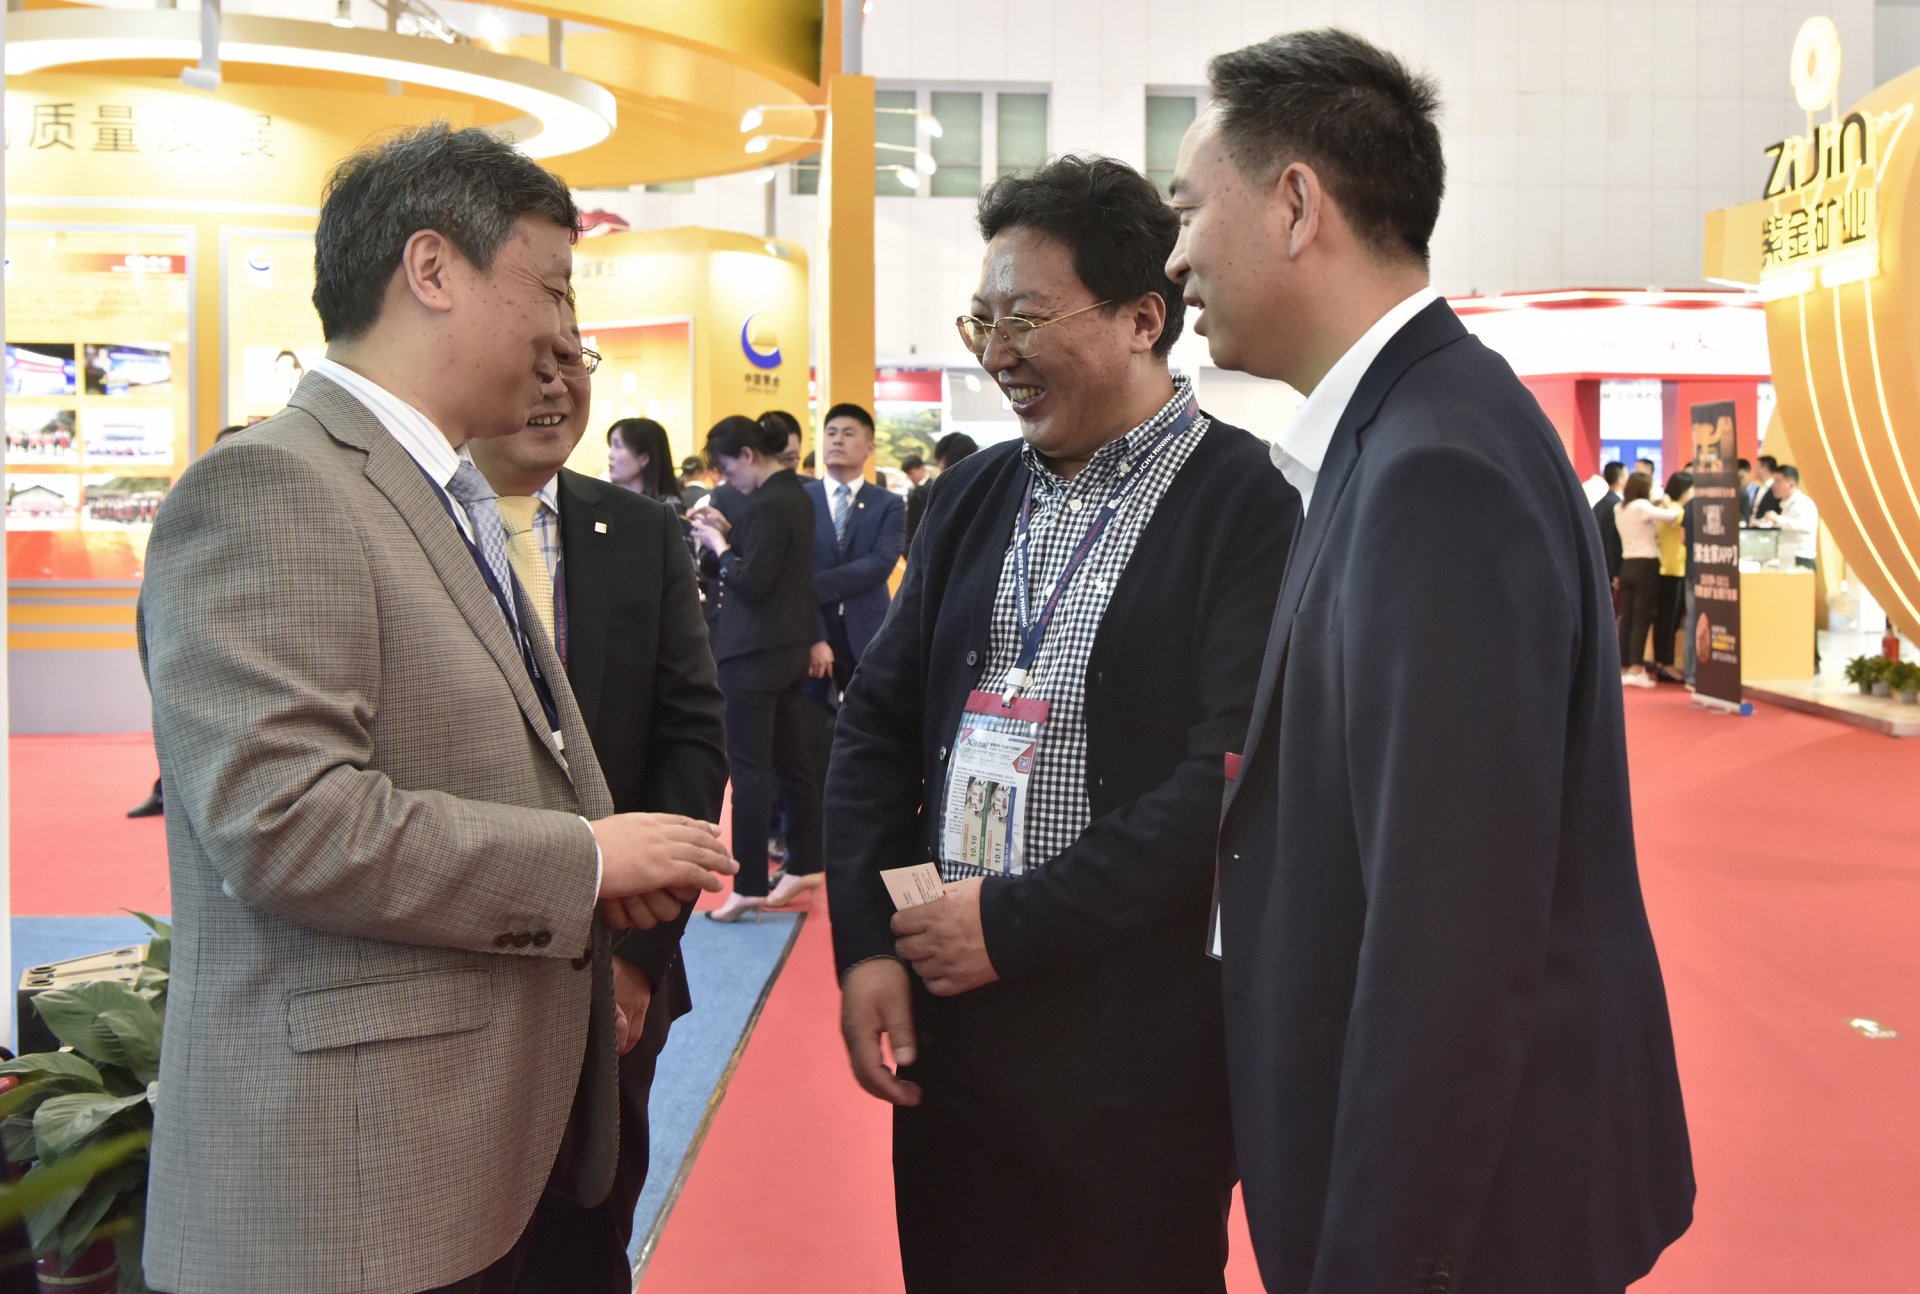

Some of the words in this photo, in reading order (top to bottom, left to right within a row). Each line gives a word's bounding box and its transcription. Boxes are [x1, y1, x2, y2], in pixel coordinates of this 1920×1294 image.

[5, 103, 274, 158] 质量发展
[1136, 452, 1156, 473] JCHX
[1151, 431, 1175, 456] MINING
[1018, 597, 1028, 628] MINING
